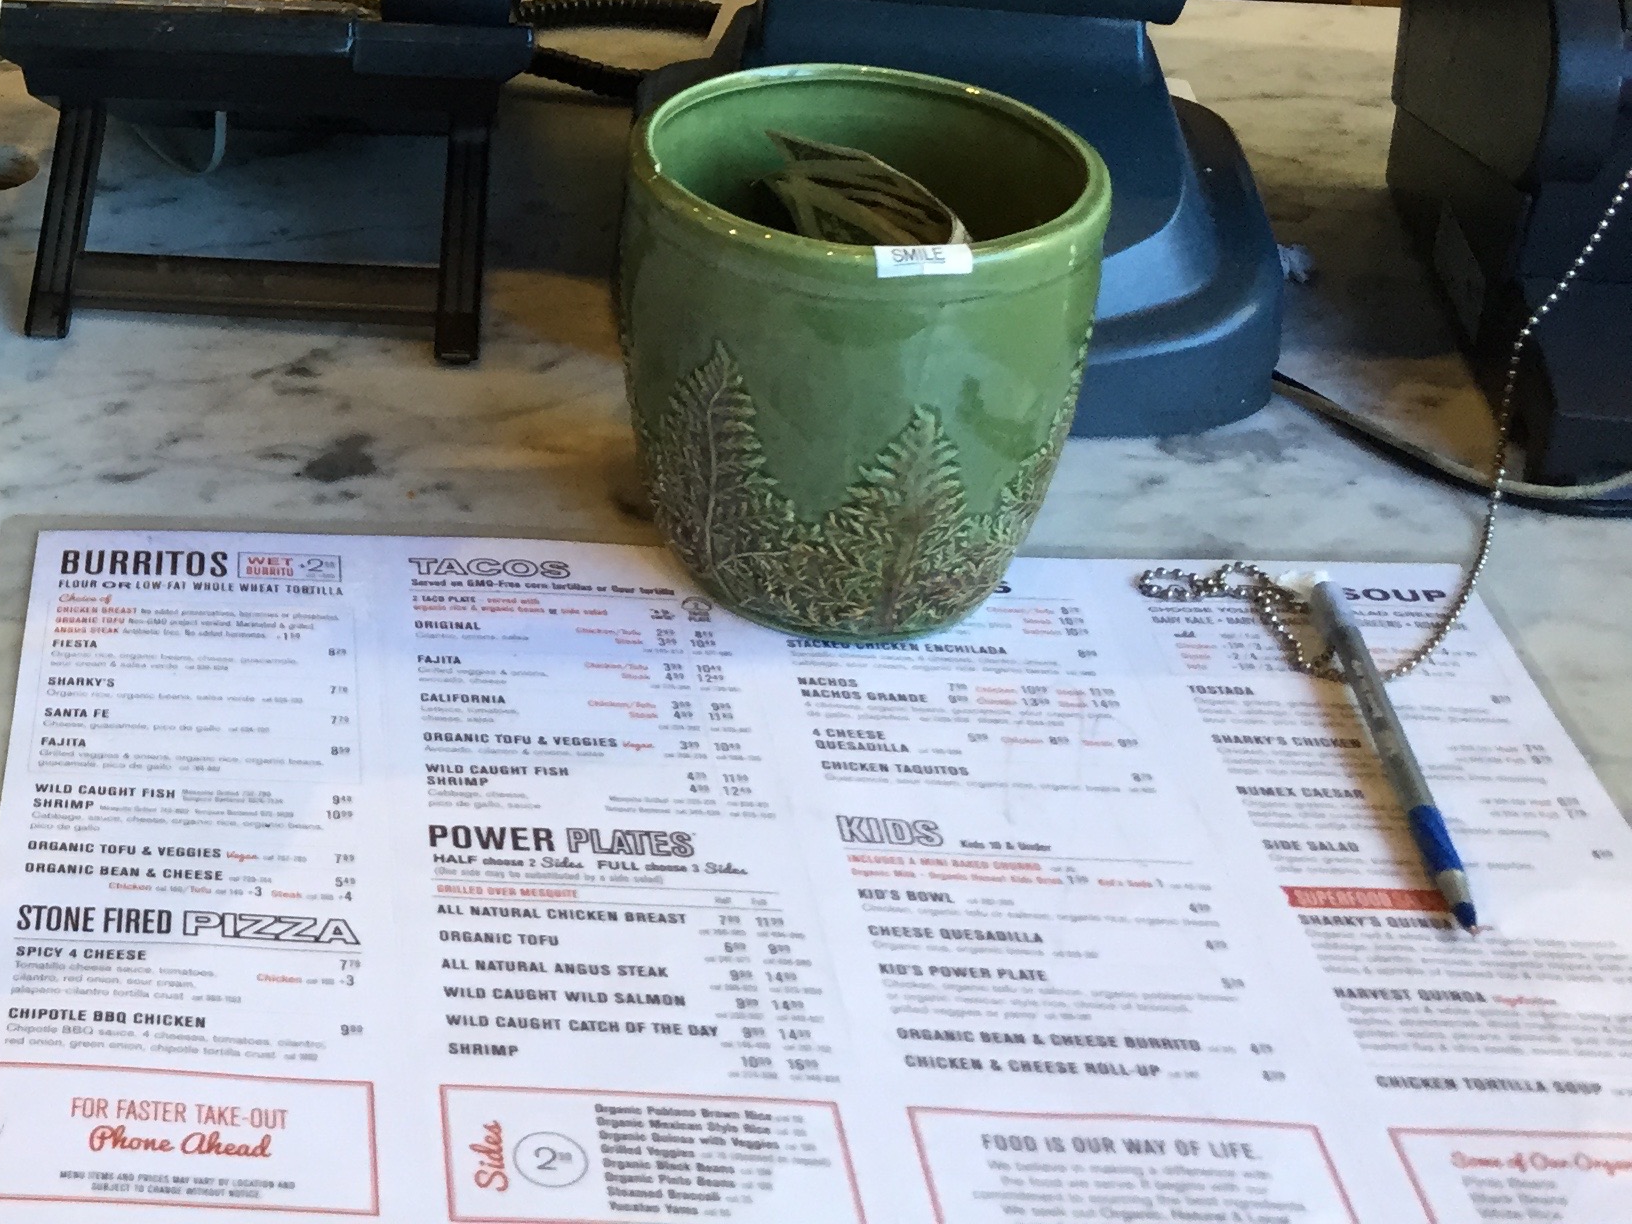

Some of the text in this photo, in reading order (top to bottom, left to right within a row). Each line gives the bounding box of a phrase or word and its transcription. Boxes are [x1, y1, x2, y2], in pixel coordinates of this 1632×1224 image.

[891, 247, 946, 263] SMILE
[61, 550, 293, 577] BURRITOS WET
[408, 558, 571, 579] TACOS
[59, 580, 97, 588] FLOUR
[102, 581, 131, 589] OR
[193, 582, 233, 592] WHOLE
[240, 584, 279, 592] WHEAT
[285, 585, 343, 595] TORTILLA
[1342, 588, 1446, 602] SOUP
[415, 620, 481, 630] ORIGINAL
[52, 640, 97, 648] FIESTA
[418, 655, 461, 664] FAJITA
[48, 677, 114, 687] SHARKY'S
[797, 677, 857, 687] NACHOS
[801, 689, 927, 702] NACHOS GRANDE
[1187, 685, 1254, 695] TOSTADA
[421, 693, 505, 704] CALIFORNIA
[45, 708, 109, 718] SANTA FE
[423, 732, 617, 747] ORGANIC TOFU & VEGGIES
[826, 728, 885, 740] CHEESE
[41, 737, 86, 747] FAJITA
[815, 740, 909, 752] QUESADILLA
[425, 764, 569, 776] WILD CAUGHT FISH
[821, 761, 969, 776] CHICKEN TAQUITOS
[427, 776, 488, 786] SHRIMP
[35, 784, 72, 793] WILD
[79, 785, 136, 796] CAUGHT
[142, 788, 175, 798] FISH
[33, 798, 94, 809] SHRIMP
[836, 815, 944, 847] KIDS
[429, 825, 694, 858] POWER PLATES
[1262, 839, 1359, 852] SIDE SALAD
[28, 841, 221, 858] ORGANIC TOFU & VEGGIES
[433, 854, 477, 864] HALF
[597, 860, 639, 871] FULL
[25, 863, 222, 880] ORGANIC BEAN & CHEESE
[858, 889, 955, 903] KID'S BOWL
[437, 905, 685, 924] ALL NATURAL CHICKEN BREAST
[17, 905, 361, 945] STONE FIRED PIZZA
[440, 930, 559, 946] ORGANIC TOFU
[868, 925, 1043, 943] CHEESE QUESADILLA
[16, 946, 145, 960] SPICY 4 CHEESE
[442, 959, 668, 977] ALL NATURAL ANGUS STEAK
[929, 966, 991, 978] POWER
[997, 969, 1047, 981] PLATE
[444, 986, 686, 1006] WILD CAUGHT WILD SALMON
[9, 1008, 205, 1028] CHIPOTLE BBQ CHICKEN
[446, 1015, 717, 1037] WILD CAUGHT CATCH OF THE DAY
[897, 1028, 974, 1042] ORGANIC
[980, 1031, 1026, 1044] BEAN
[1033, 1034, 1045, 1045] &
[1050, 1034, 1118, 1048] CHEESE
[449, 1043, 518, 1056] SHRIMP
[905, 1055, 983, 1070] CHICKEN
[990, 1059, 1002, 1071] &
[1008, 1060, 1078, 1074] CHEESE
[71, 1097, 287, 1129] FOR FASTER TAKE-OUT
[89, 1125, 272, 1157] Phone Ahead
[981, 1134, 1038, 1152] FOOD
[1044, 1137, 1066, 1153] IS
[1071, 1137, 1116, 1153] OUR
[1122, 1139, 1165, 1155] WAY
[1174, 1139, 1200, 1157] OF
[469, 1120, 509, 1192] Sides
